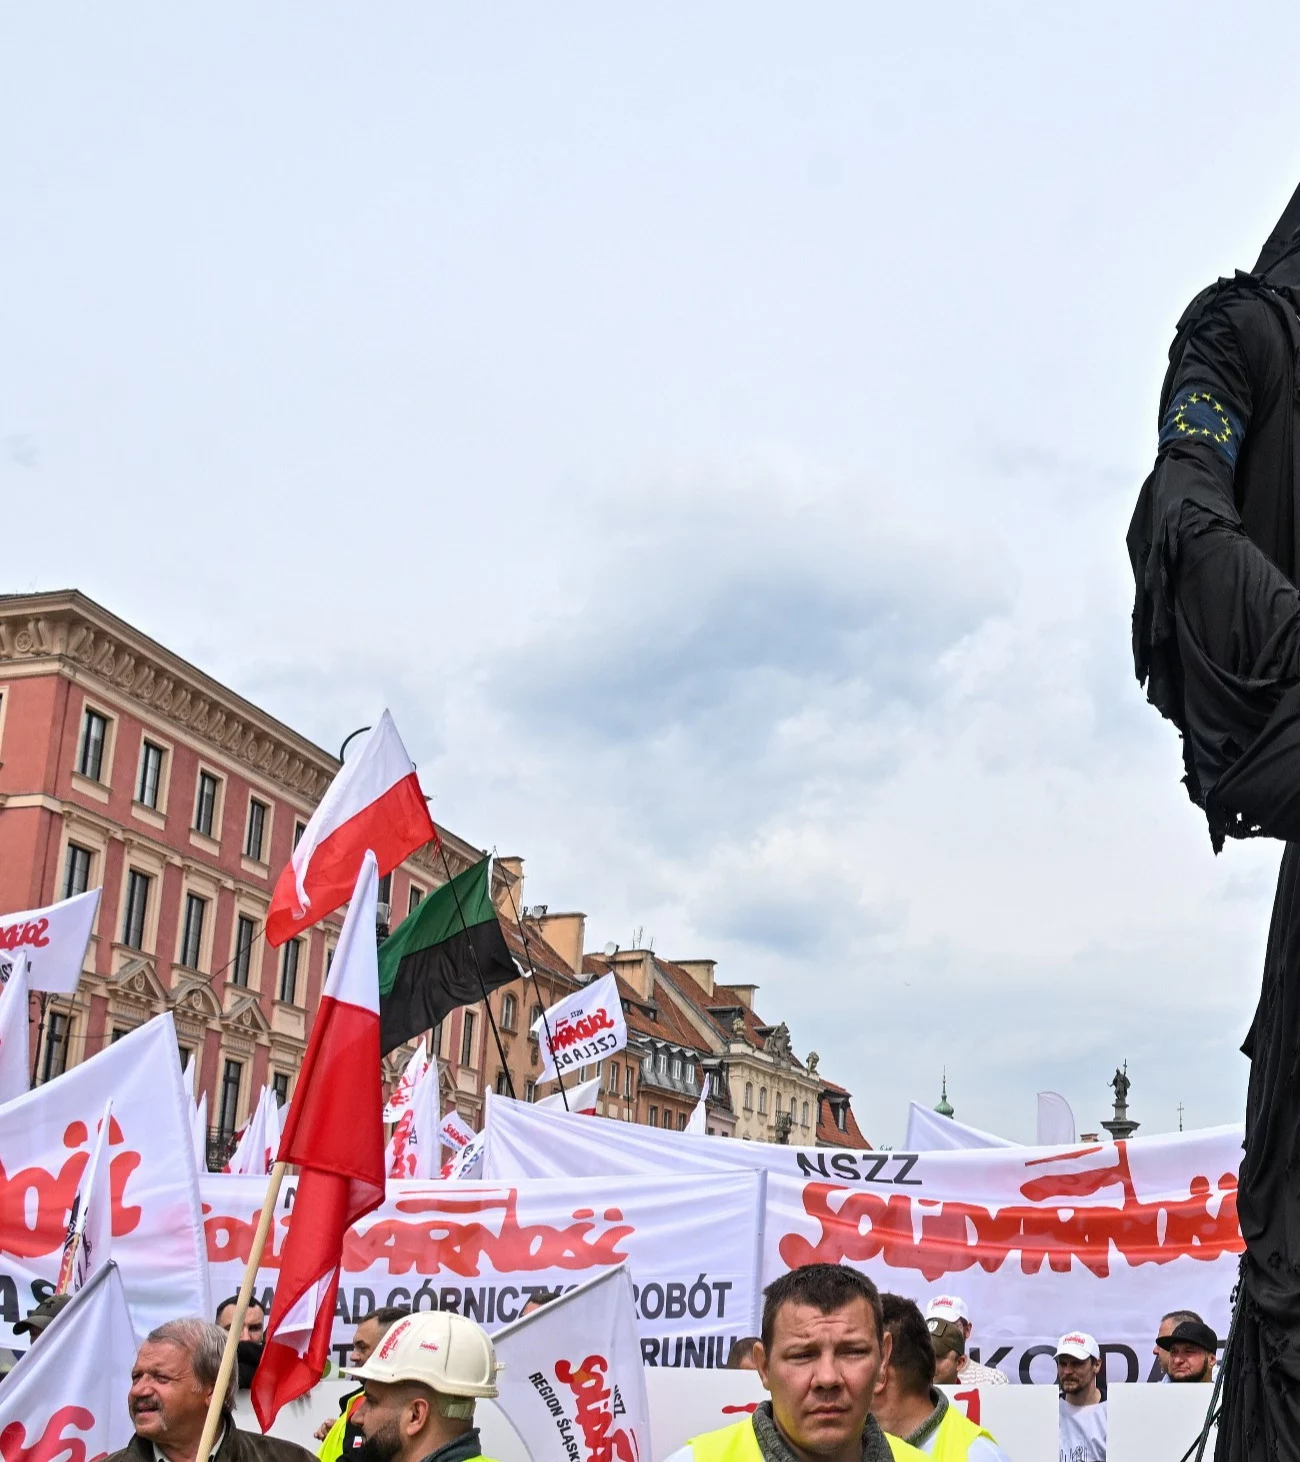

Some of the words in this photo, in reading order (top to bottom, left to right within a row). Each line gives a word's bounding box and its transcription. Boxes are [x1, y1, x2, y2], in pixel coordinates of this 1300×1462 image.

[796, 1152, 923, 1185] NSZZ
[528, 1371, 564, 1418] REGION
[556, 1417, 581, 1462] ŚLĄSK
